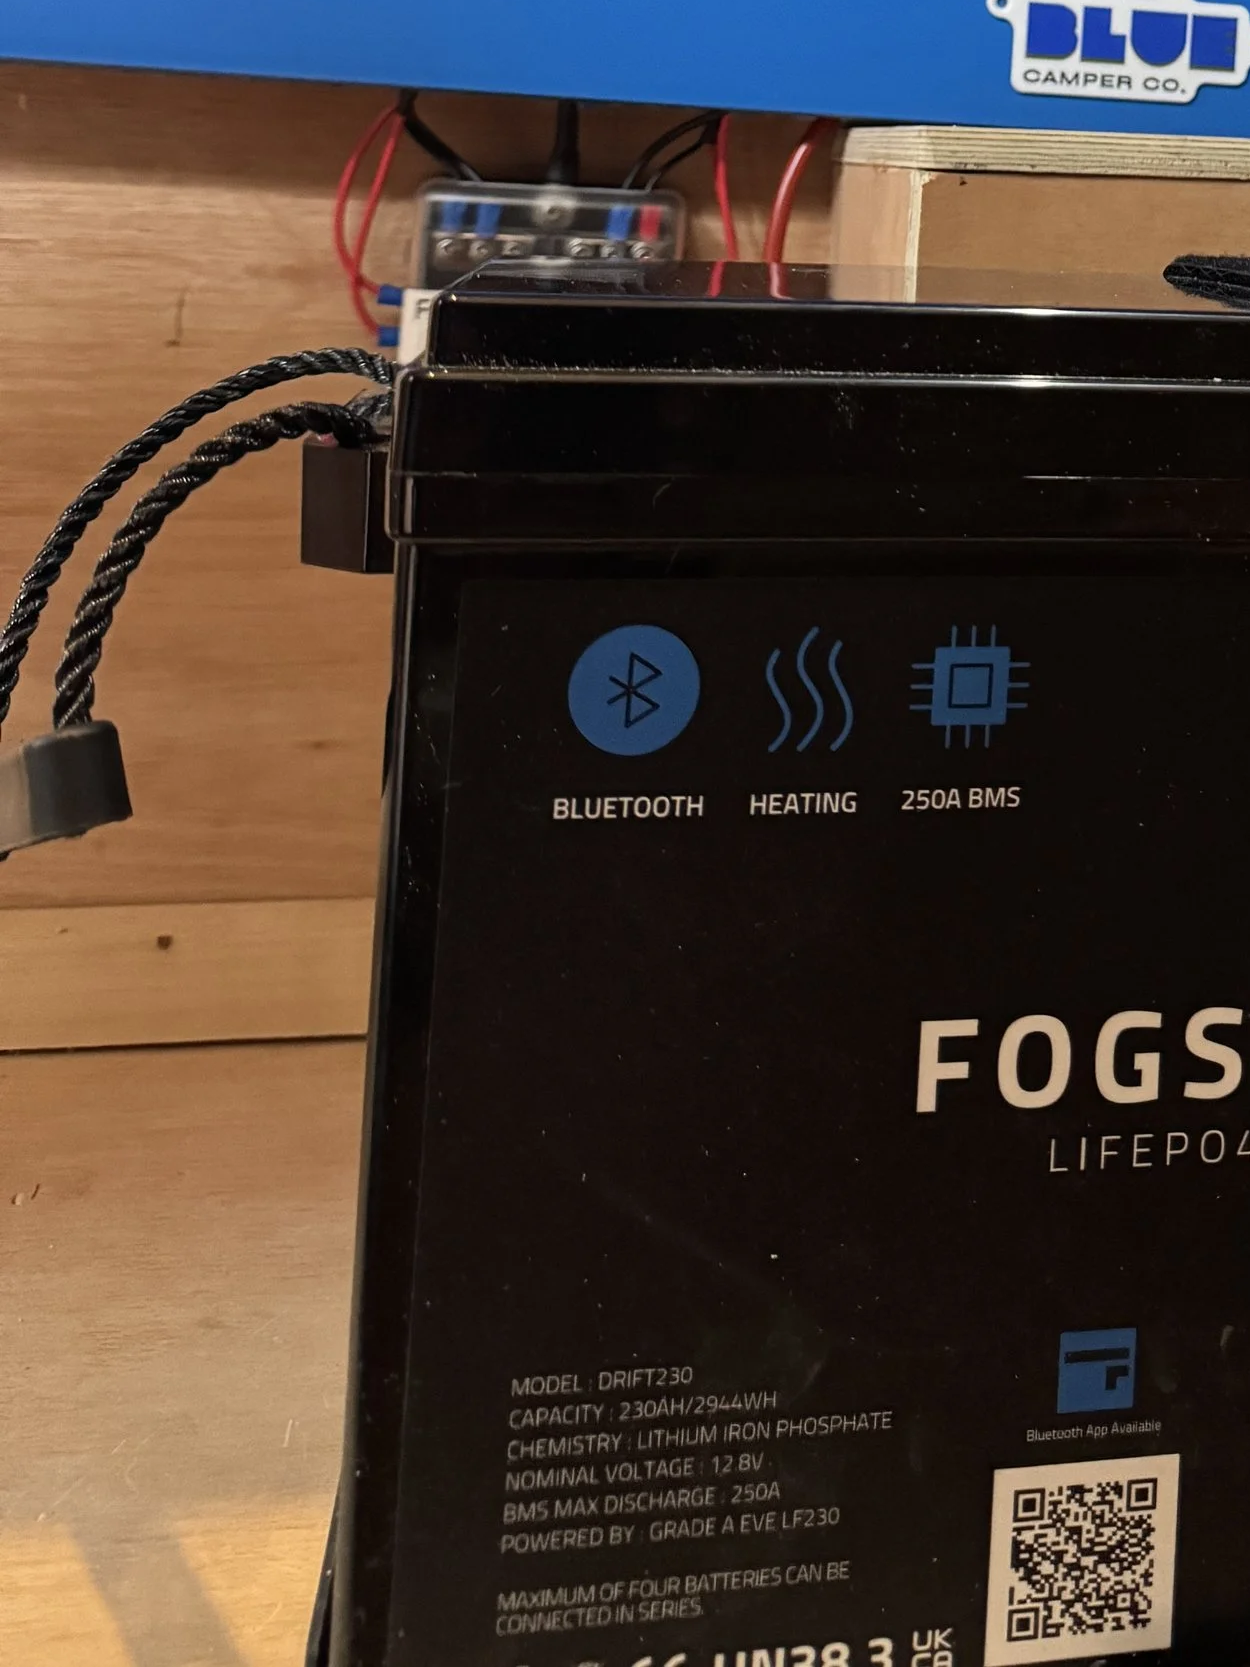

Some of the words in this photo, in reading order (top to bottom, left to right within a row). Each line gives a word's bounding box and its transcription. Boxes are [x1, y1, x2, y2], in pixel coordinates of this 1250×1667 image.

[1025, 2, 1239, 72] BLUE
[1023, 68, 1132, 91] CAMPER
[1143, 76, 1187, 95] CO.
[552, 795, 705, 821] BLUETOOTH
[749, 791, 859, 816] HEATING
[901, 788, 962, 811] 250A
[968, 786, 1021, 810] BMS
[510, 1374, 584, 1397] MODEL
[598, 1366, 693, 1391] DRIFT230
[508, 1403, 604, 1430] CAPACITY
[619, 1391, 777, 1421] 230AH/2944WH
[507, 1432, 623, 1461] CHEMISTRY
[637, 1424, 717, 1450] LITHIUM
[723, 1421, 770, 1443] IRON
[776, 1411, 893, 1439] PHOSPHATE
[1026, 1425, 1083, 1442] Bluetooth
[1086, 1424, 1108, 1439] App
[1111, 1419, 1161, 1433] Available
[505, 1465, 600, 1492] NOMINAL
[604, 1457, 695, 1483] VOLTAGE
[503, 1500, 549, 1525] BMS
[554, 1496, 600, 1518] MAX
[604, 1486, 717, 1515] DISCHARGE
[730, 1481, 781, 1504] 250A
[500, 1528, 604, 1555] POWERED
[609, 1525, 635, 1546] BY
[650, 1517, 717, 1542] GRADE
[721, 1514, 735, 1535] A
[740, 1511, 776, 1533] EVE
[782, 1506, 840, 1529] LF230
[498, 1585, 596, 1612] MAXIMUM
[600, 1581, 625, 1602] OF
[628, 1576, 681, 1599] FOUR
[685, 1567, 781, 1595] BATTERIES
[785, 1564, 823, 1584] CAN
[826, 1561, 849, 1580] BE
[496, 1606, 611, 1637] CONNECTED
[615, 1604, 634, 1624] IN
[912, 1628, 953, 1651] UK
